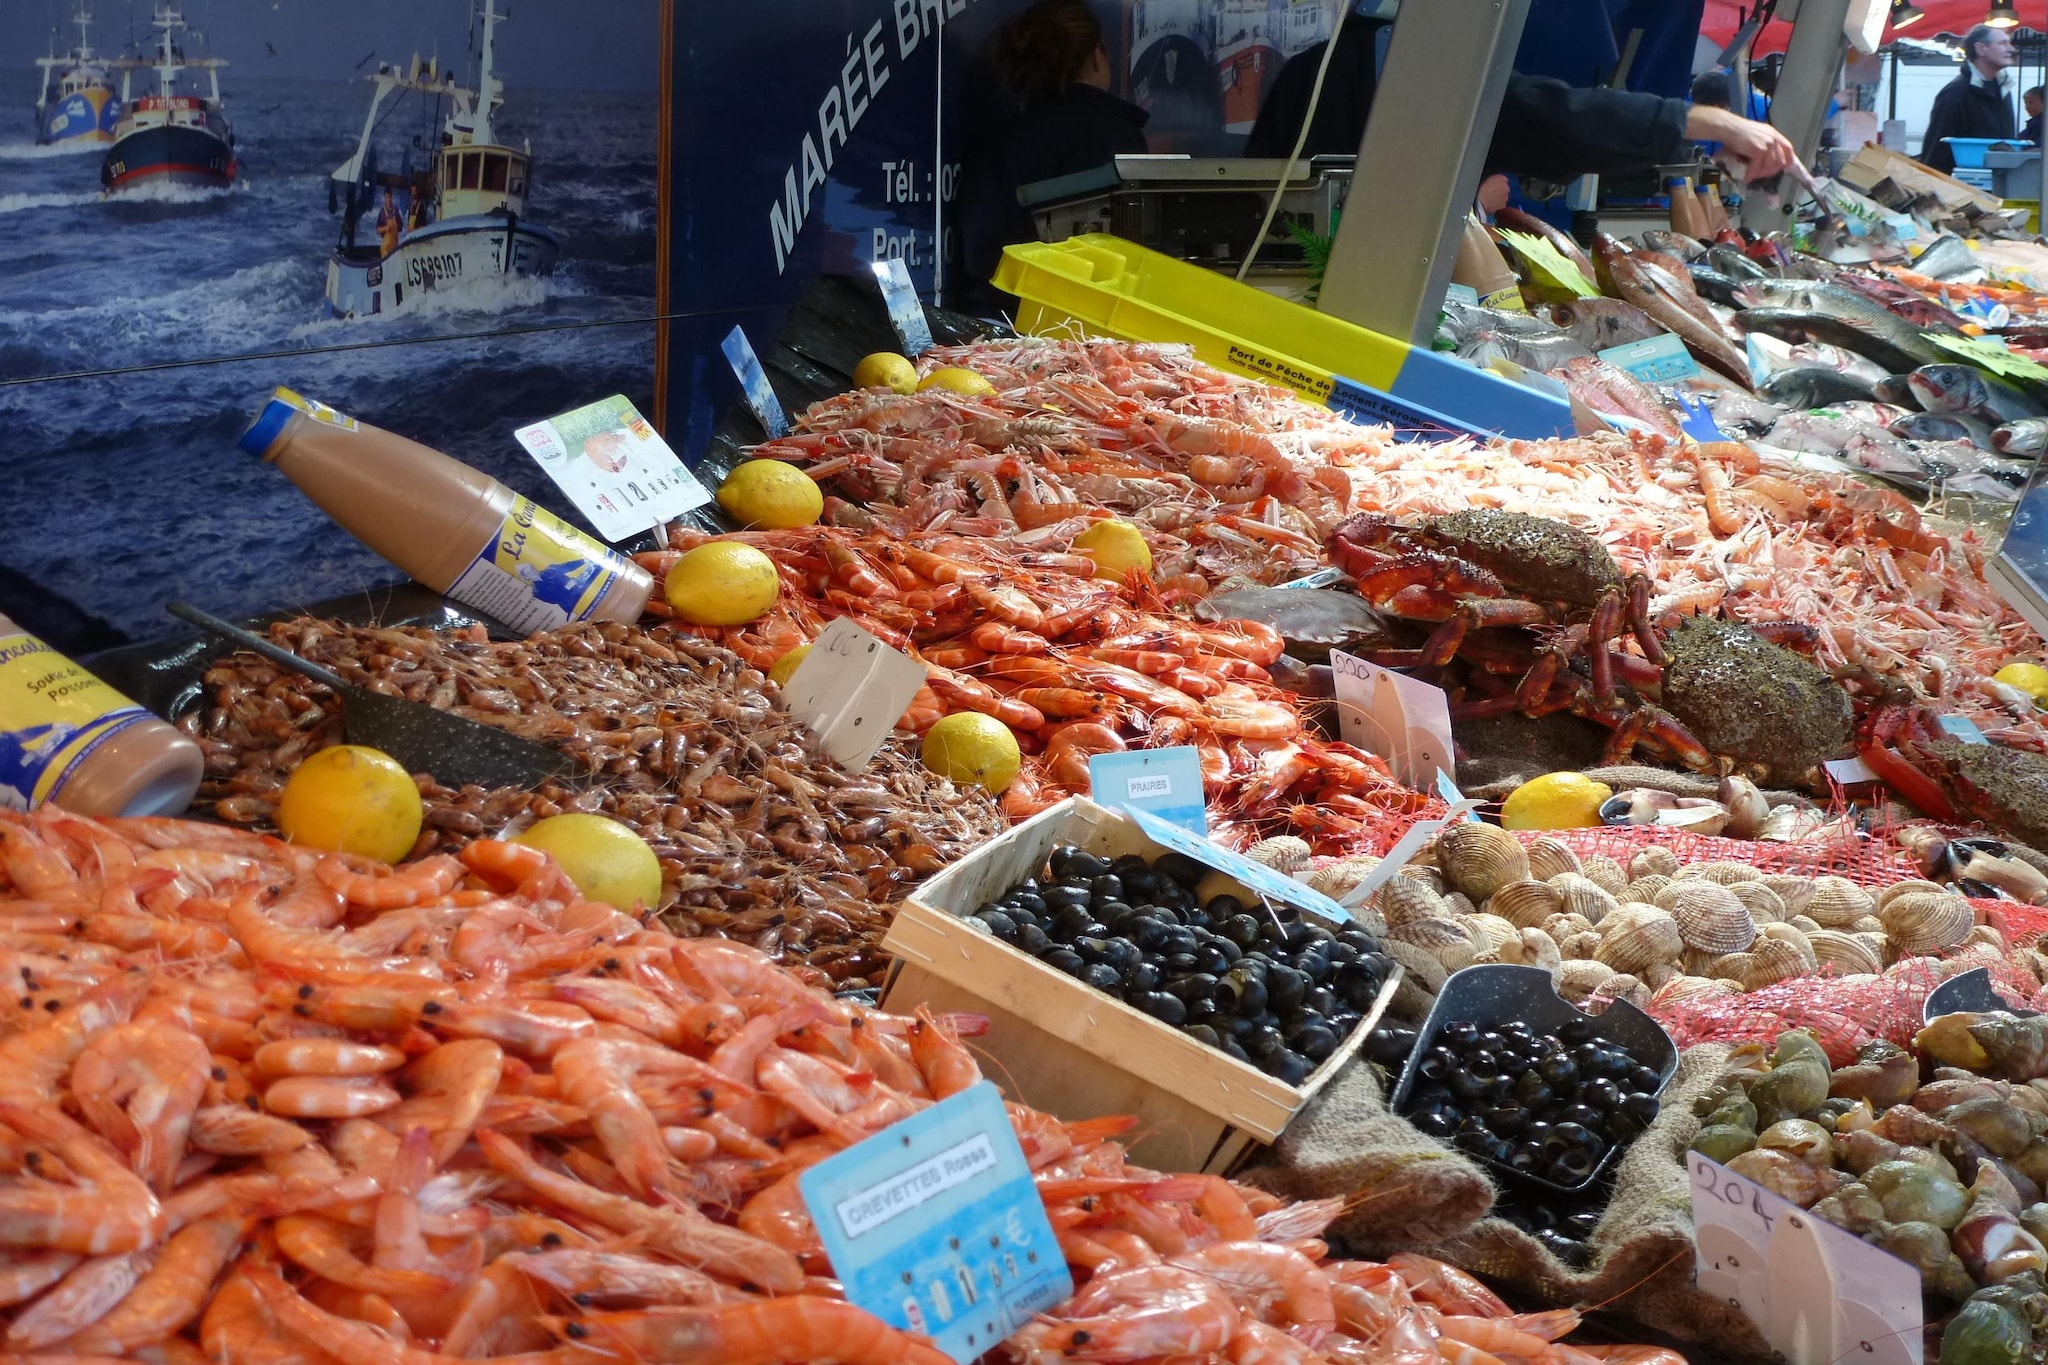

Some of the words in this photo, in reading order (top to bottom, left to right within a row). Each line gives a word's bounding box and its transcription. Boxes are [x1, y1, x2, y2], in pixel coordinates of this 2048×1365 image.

[770, 18, 890, 277] MARÉE
[882, 158, 920, 203] Tél.
[873, 227, 921, 266] Port.
[1227, 355, 1246, 369] Toute
[1247, 362, 1280, 381] détention
[1281, 374, 1306, 392] illégale
[1307, 385, 1321, 397] fera
[1229, 346, 1256, 362] Port
[1257, 357, 1272, 369] de
[1276, 363, 1313, 385] Pêche
[1316, 379, 1330, 391] de
[1335, 386, 1378, 409] Lorient
[501, 531, 527, 560] La
[1130, 779, 1168, 793] PRAIRES
[848, 1167, 941, 1224] CREVETTES
